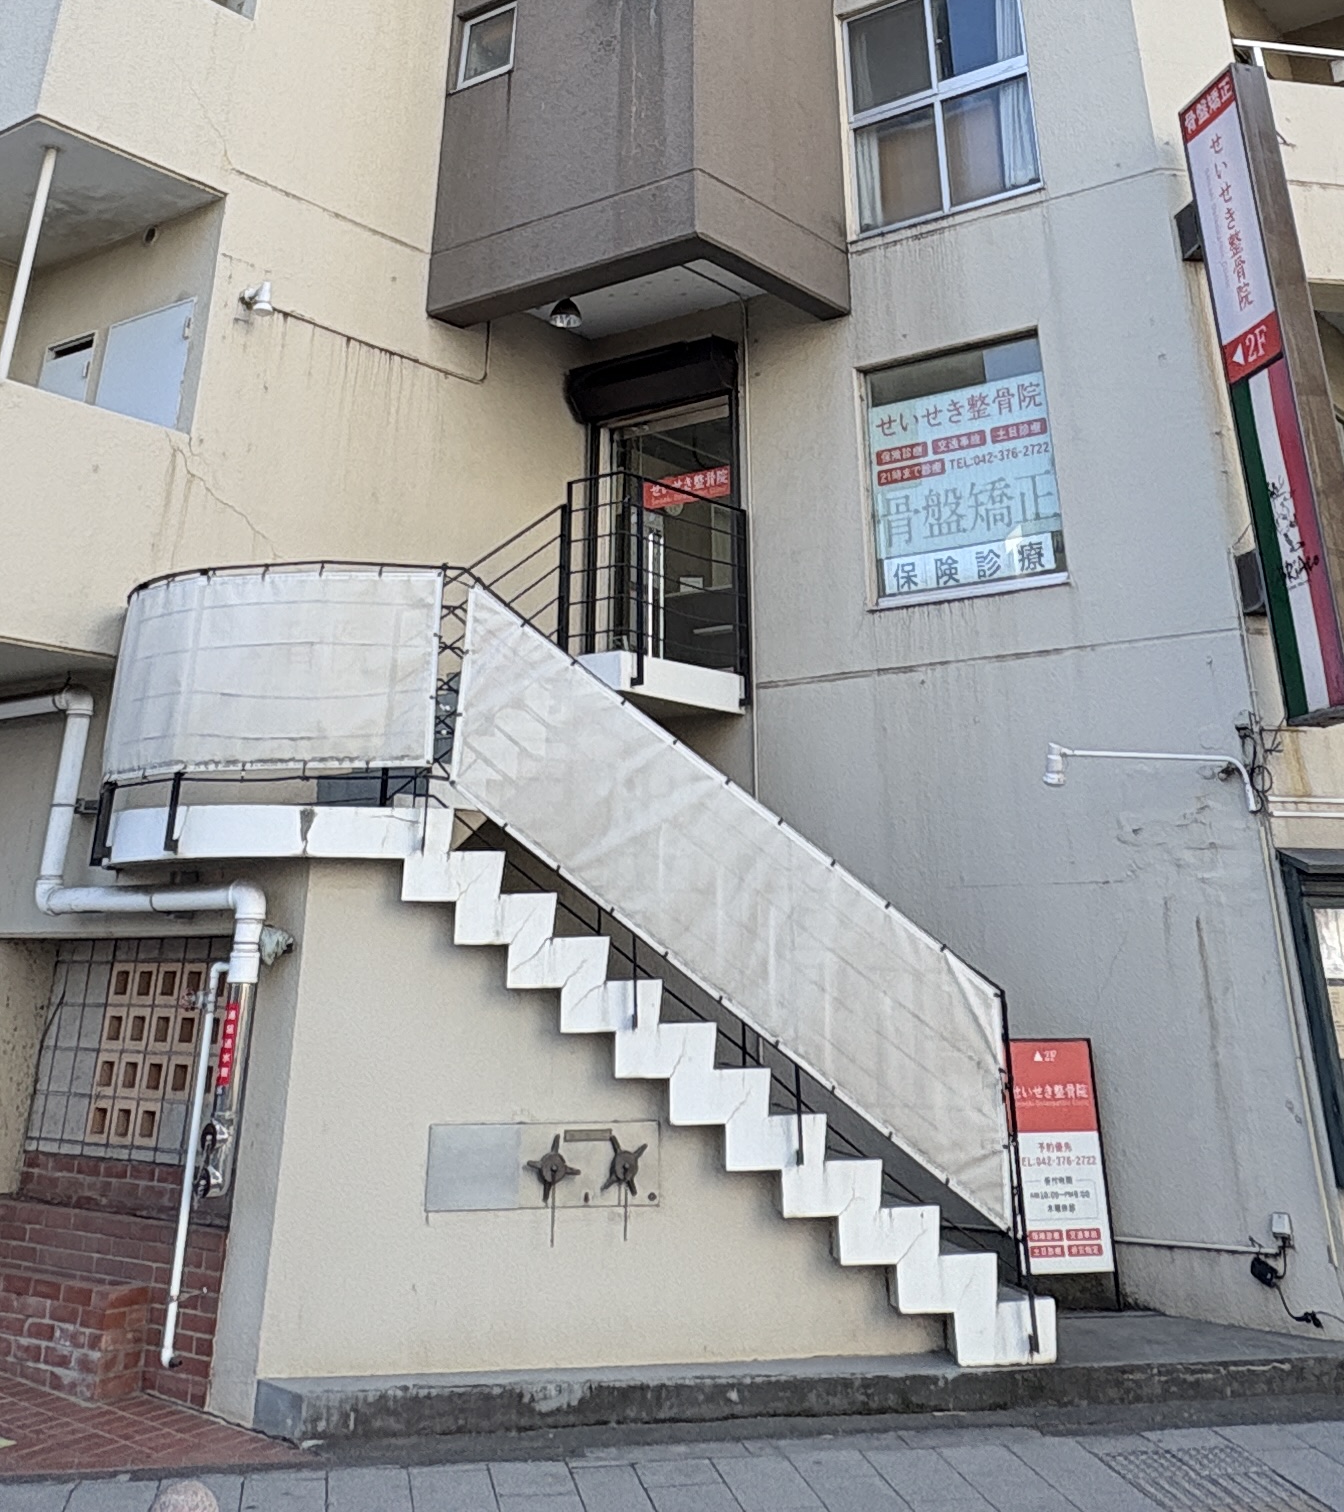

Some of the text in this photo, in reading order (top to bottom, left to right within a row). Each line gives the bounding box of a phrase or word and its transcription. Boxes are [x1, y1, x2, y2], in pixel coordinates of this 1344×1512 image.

[1184, 75, 1233, 134] 骨盤矯正
[1209, 133, 1254, 312] せいせき整骨院
[1244, 324, 1269, 363] 2F
[874, 381, 1044, 438] せいせき整骨院
[877, 469, 1062, 549] 骨盤矯正
[892, 540, 1046, 590] 保険診療
[1013, 1082, 1089, 1099] せいせき整骨院
